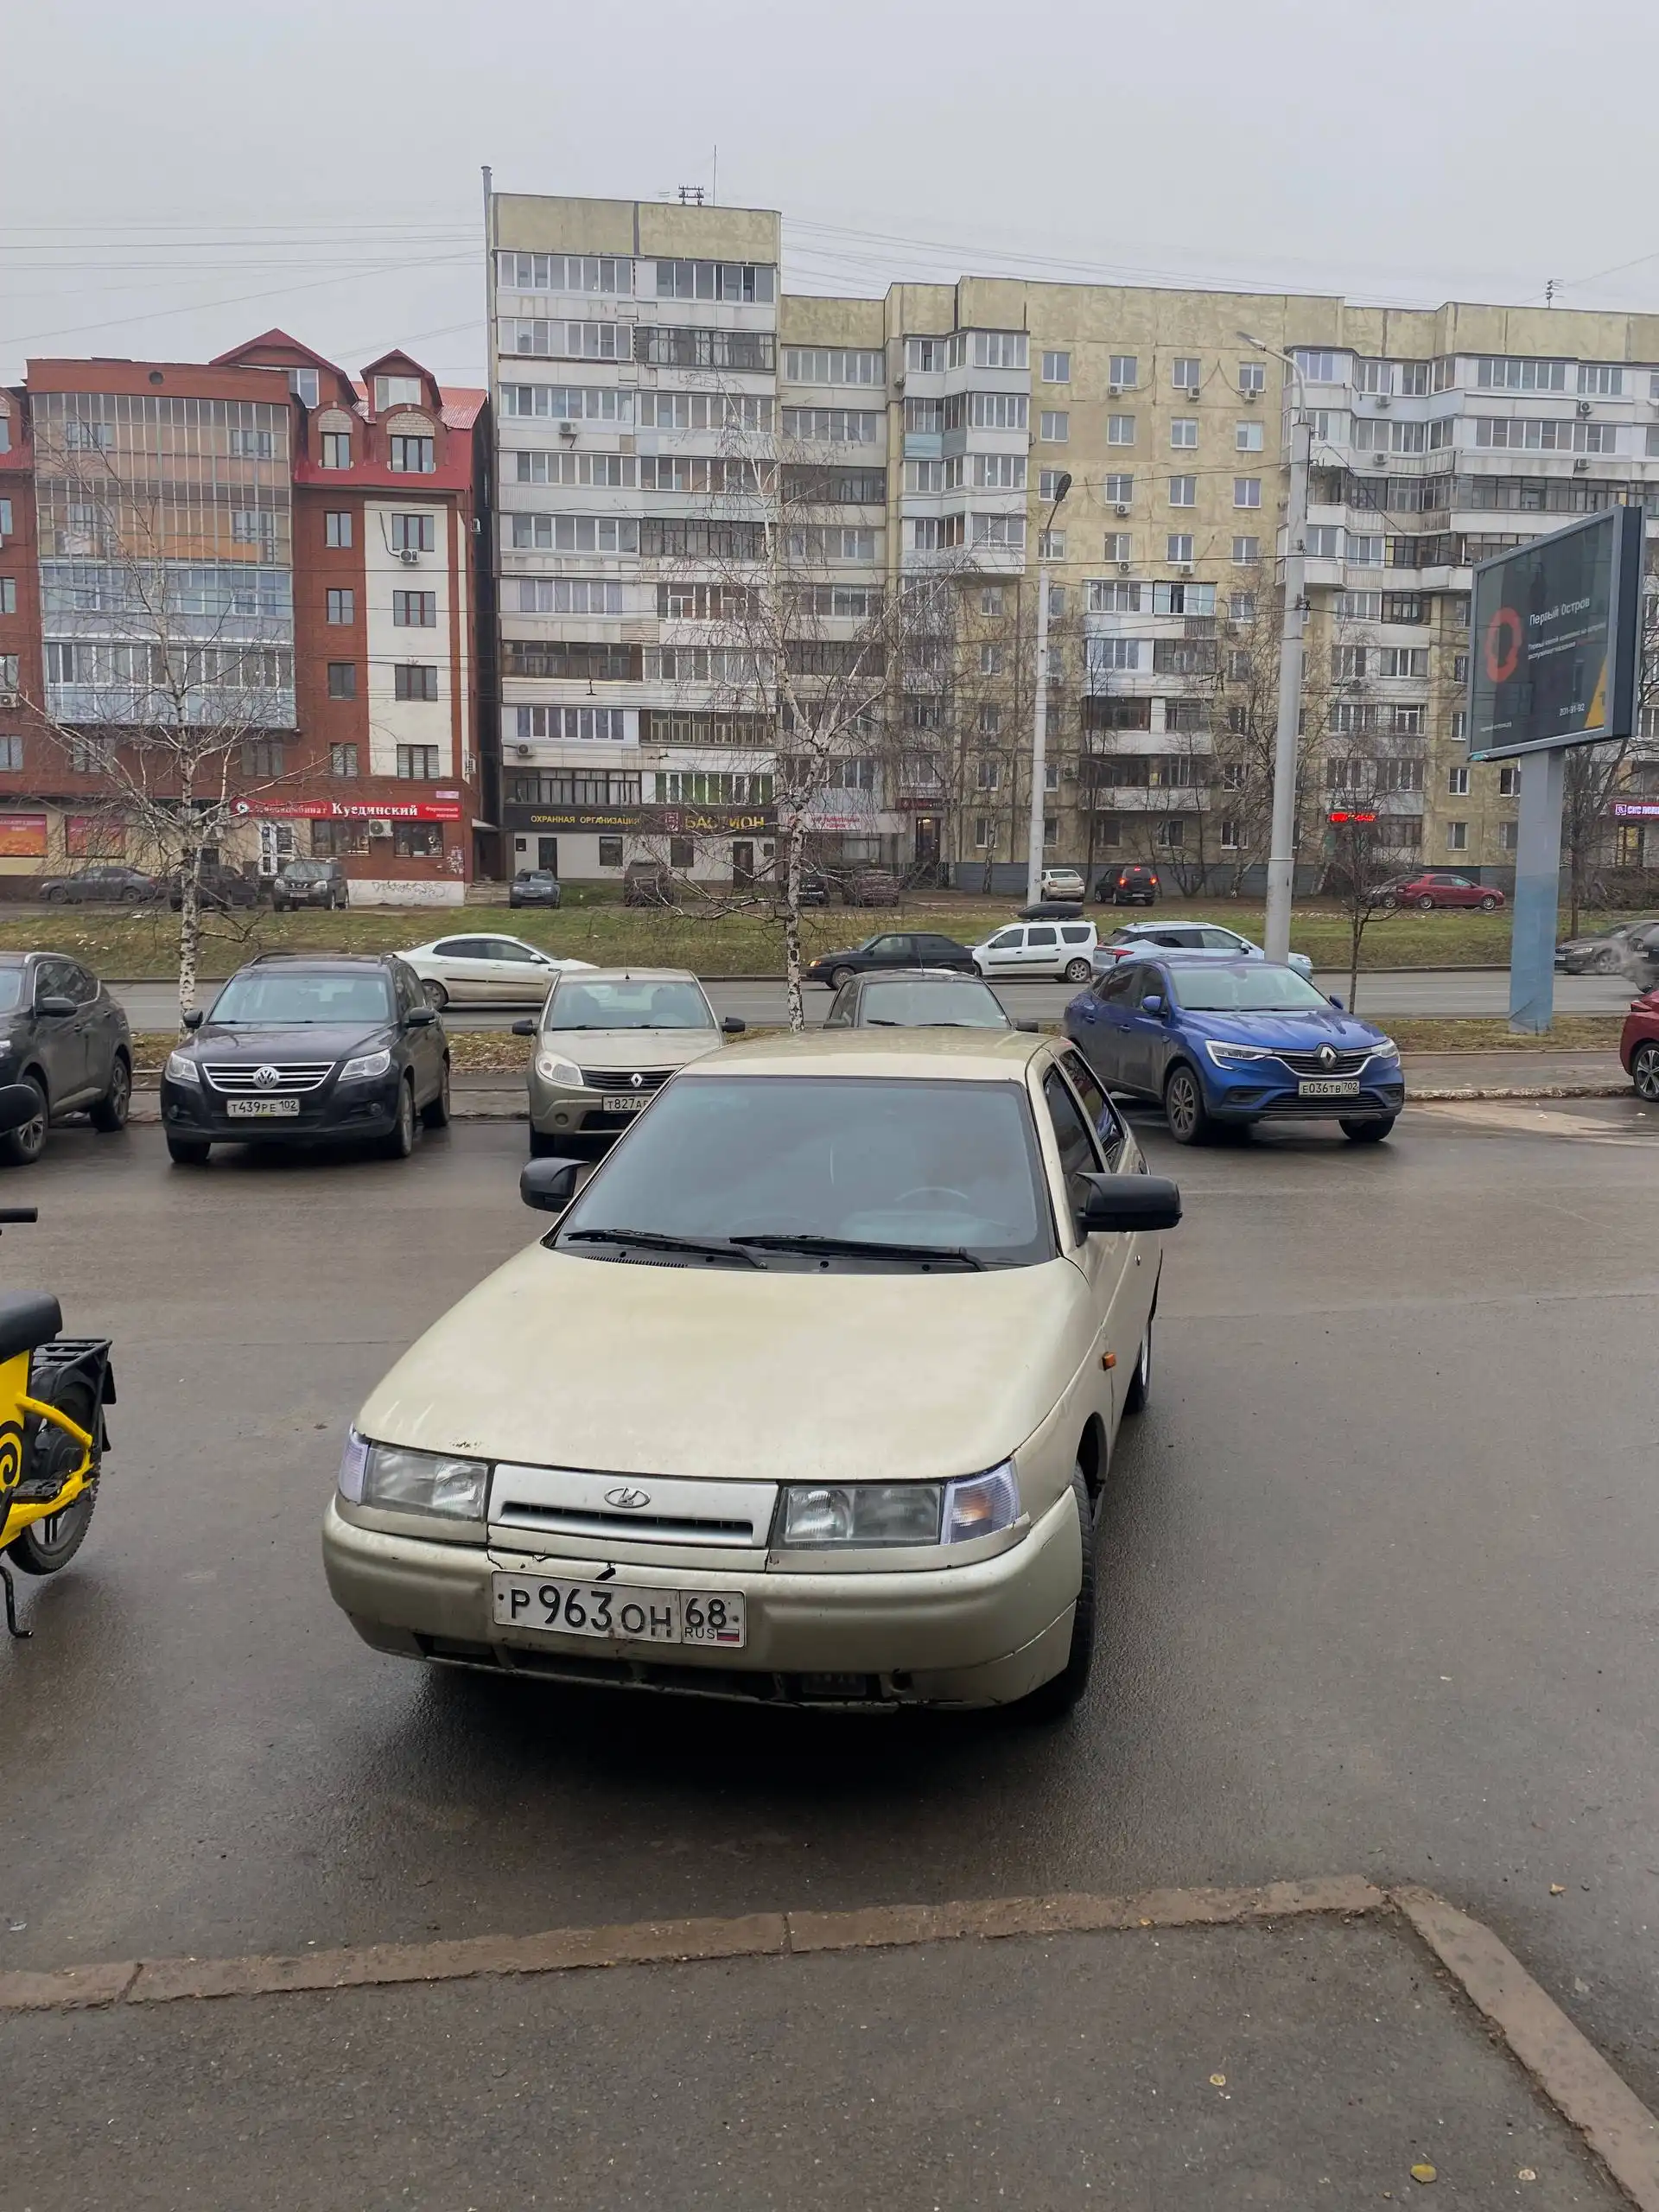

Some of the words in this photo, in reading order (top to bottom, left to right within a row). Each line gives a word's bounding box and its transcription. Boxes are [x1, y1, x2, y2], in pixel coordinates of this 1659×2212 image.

[1561, 597, 1591, 616] Остров
[332, 802, 418, 817] Куединский
[531, 815, 575, 823] ОХРАННАЯ
[580, 816, 640, 825] ОРГАНИЗАЦИЯ
[511, 1585, 671, 1638] Р963ОН
[685, 1597, 727, 1628] 68
[684, 1626, 715, 1640] RUS
